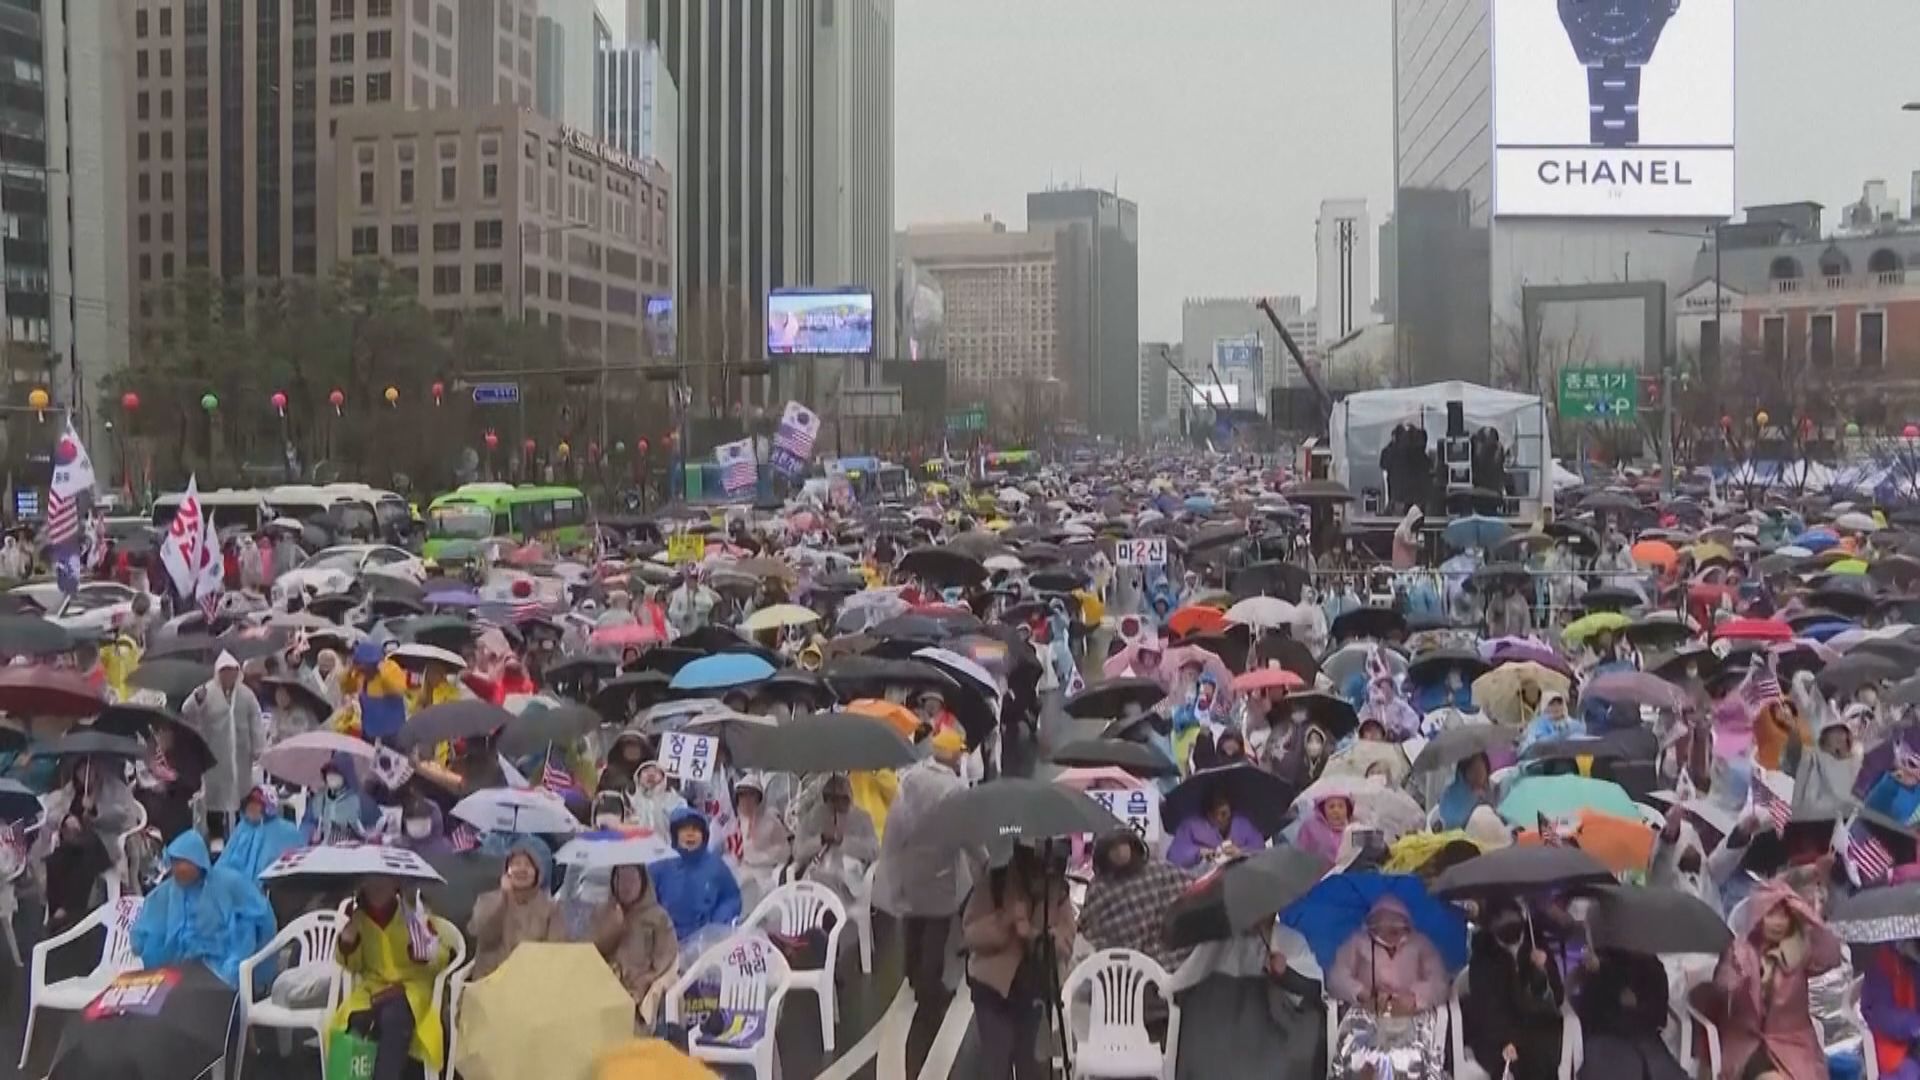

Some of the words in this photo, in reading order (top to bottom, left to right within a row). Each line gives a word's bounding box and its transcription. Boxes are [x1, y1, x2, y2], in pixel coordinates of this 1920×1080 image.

[1537, 160, 1692, 184] CHANEL
[1566, 373, 1626, 389] 종로1가
[1119, 540, 1162, 562] 마2산
